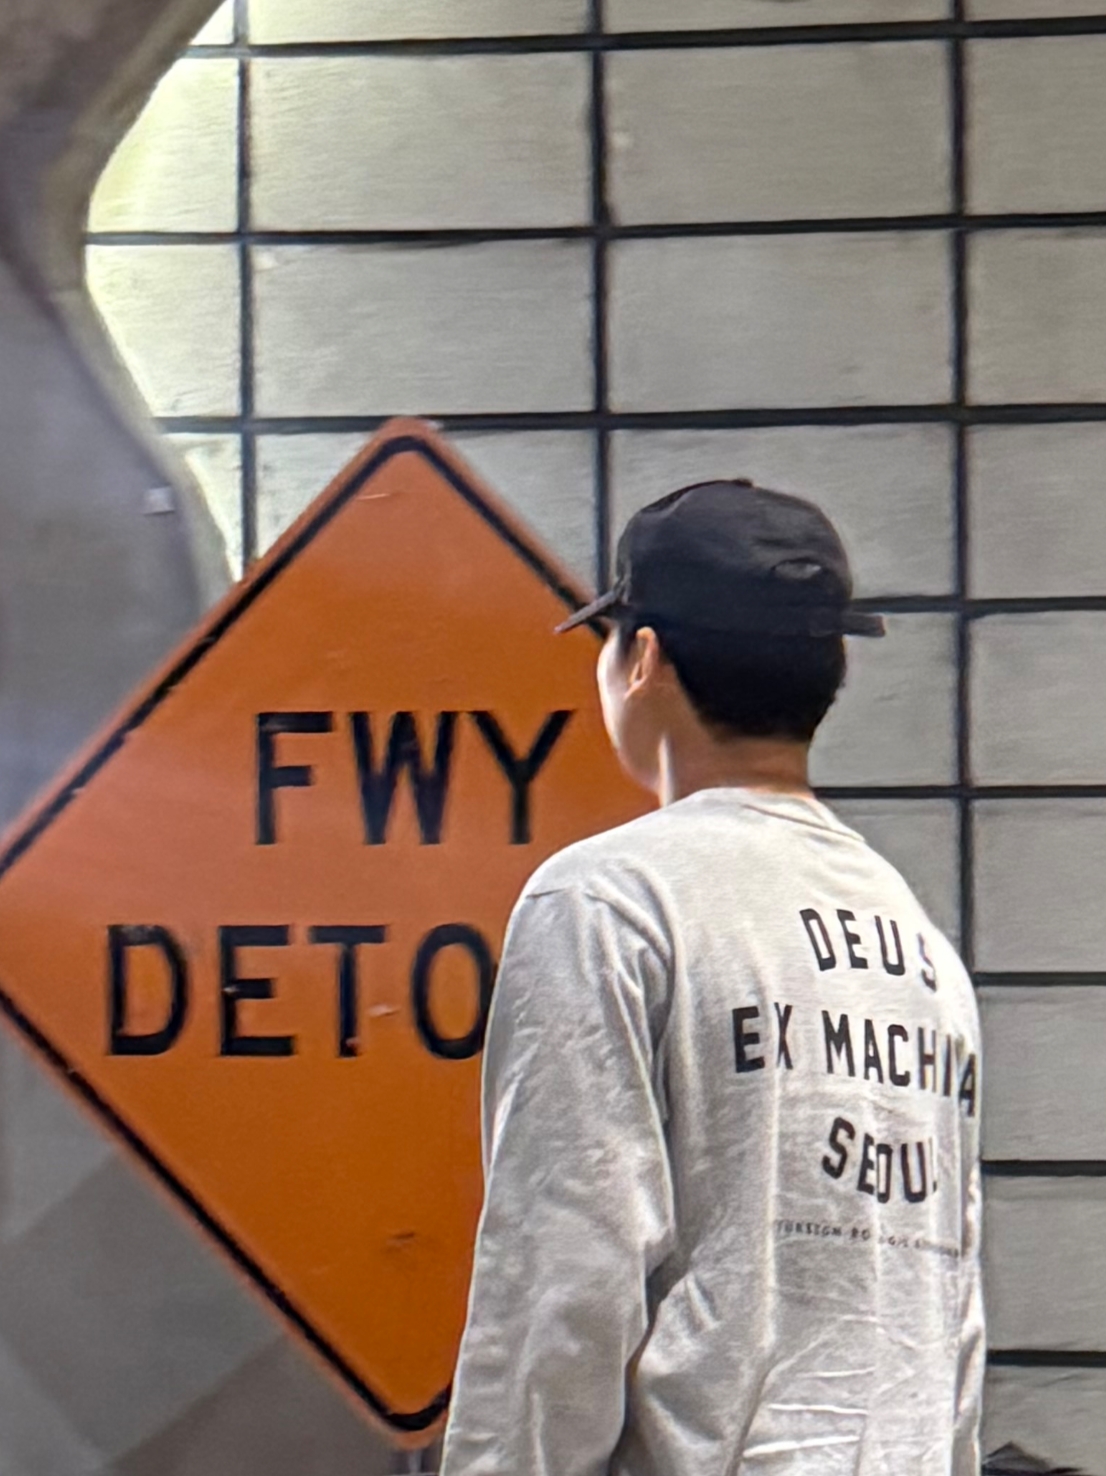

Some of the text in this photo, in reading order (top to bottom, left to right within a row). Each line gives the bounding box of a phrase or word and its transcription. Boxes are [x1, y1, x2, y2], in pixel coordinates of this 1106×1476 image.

[255, 709, 577, 846] FWY
[104, 922, 499, 1061] DETO
[799, 907, 938, 993] DEUS
[732, 1002, 794, 1074] EX
